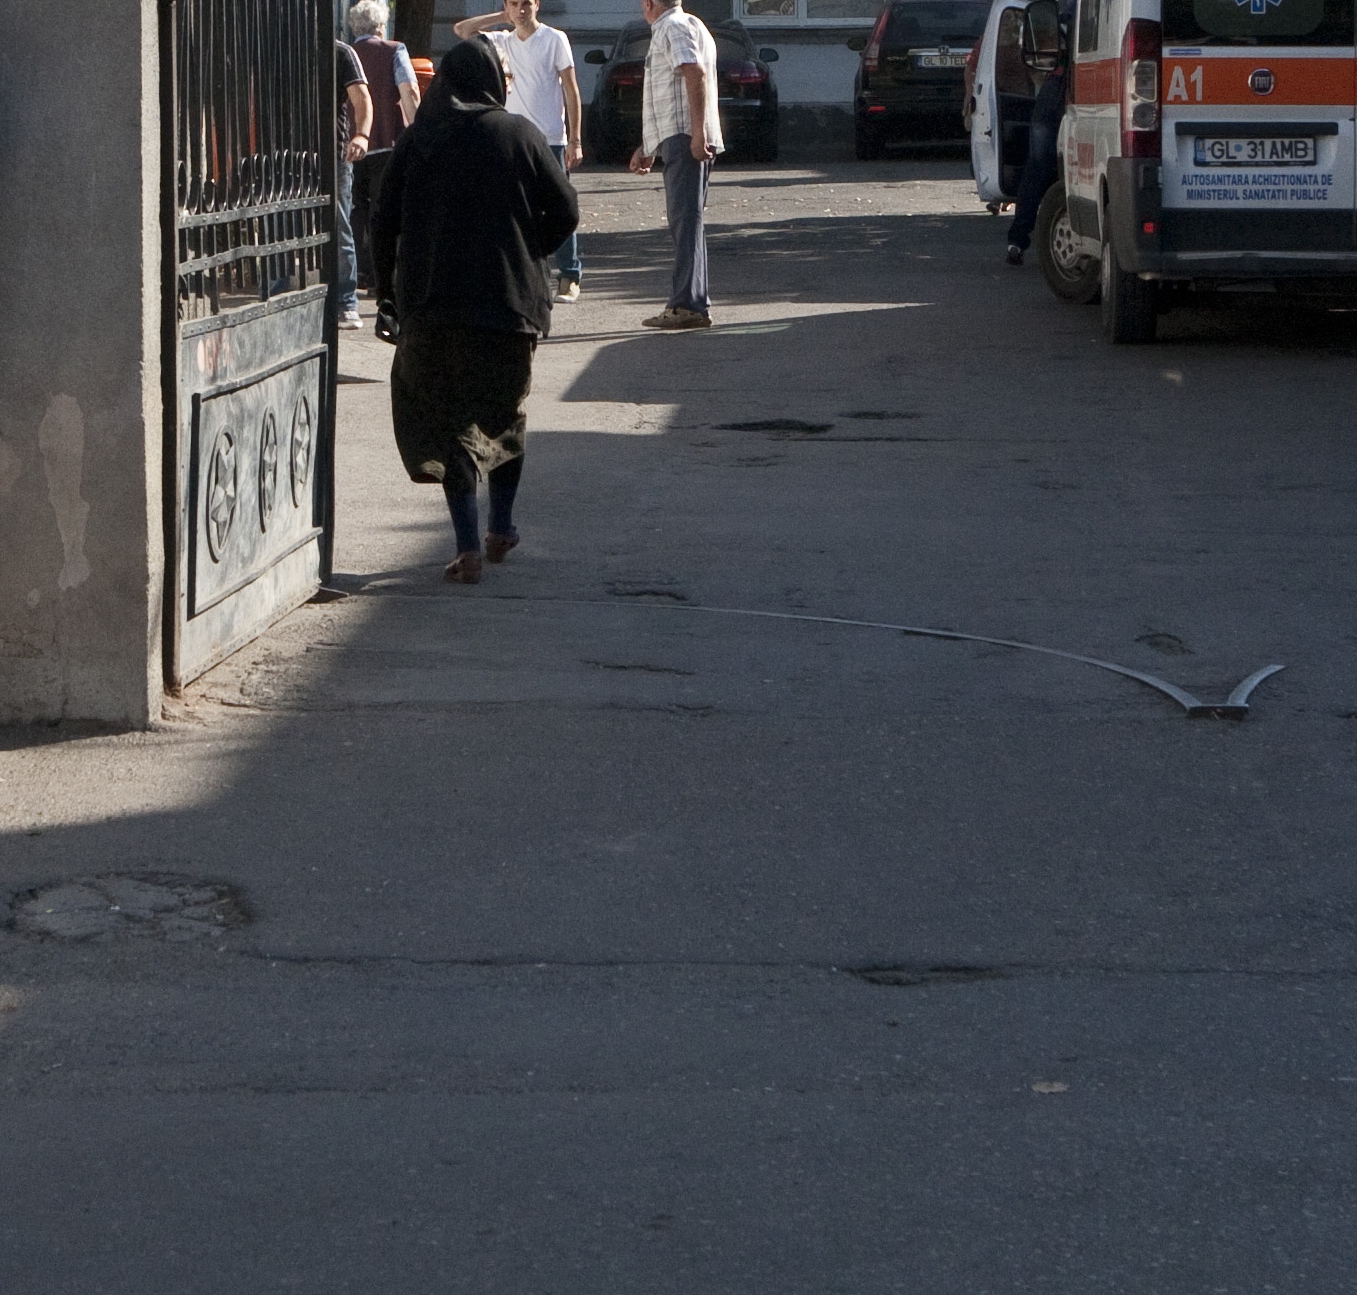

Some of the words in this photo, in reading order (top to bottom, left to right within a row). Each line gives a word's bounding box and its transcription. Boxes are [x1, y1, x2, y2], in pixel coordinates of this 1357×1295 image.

[1166, 65, 1203, 102] A1
[1210, 140, 1237, 160] GL
[1181, 174, 1250, 186] AUTOSANITARA
[1251, 174, 1319, 186] ACHIZITIONATA
[1321, 174, 1333, 186] DE
[1186, 189, 1241, 201] MINISTERUL
[1242, 189, 1288, 201] SANATATII
[1290, 189, 1329, 201] PUBLICE
